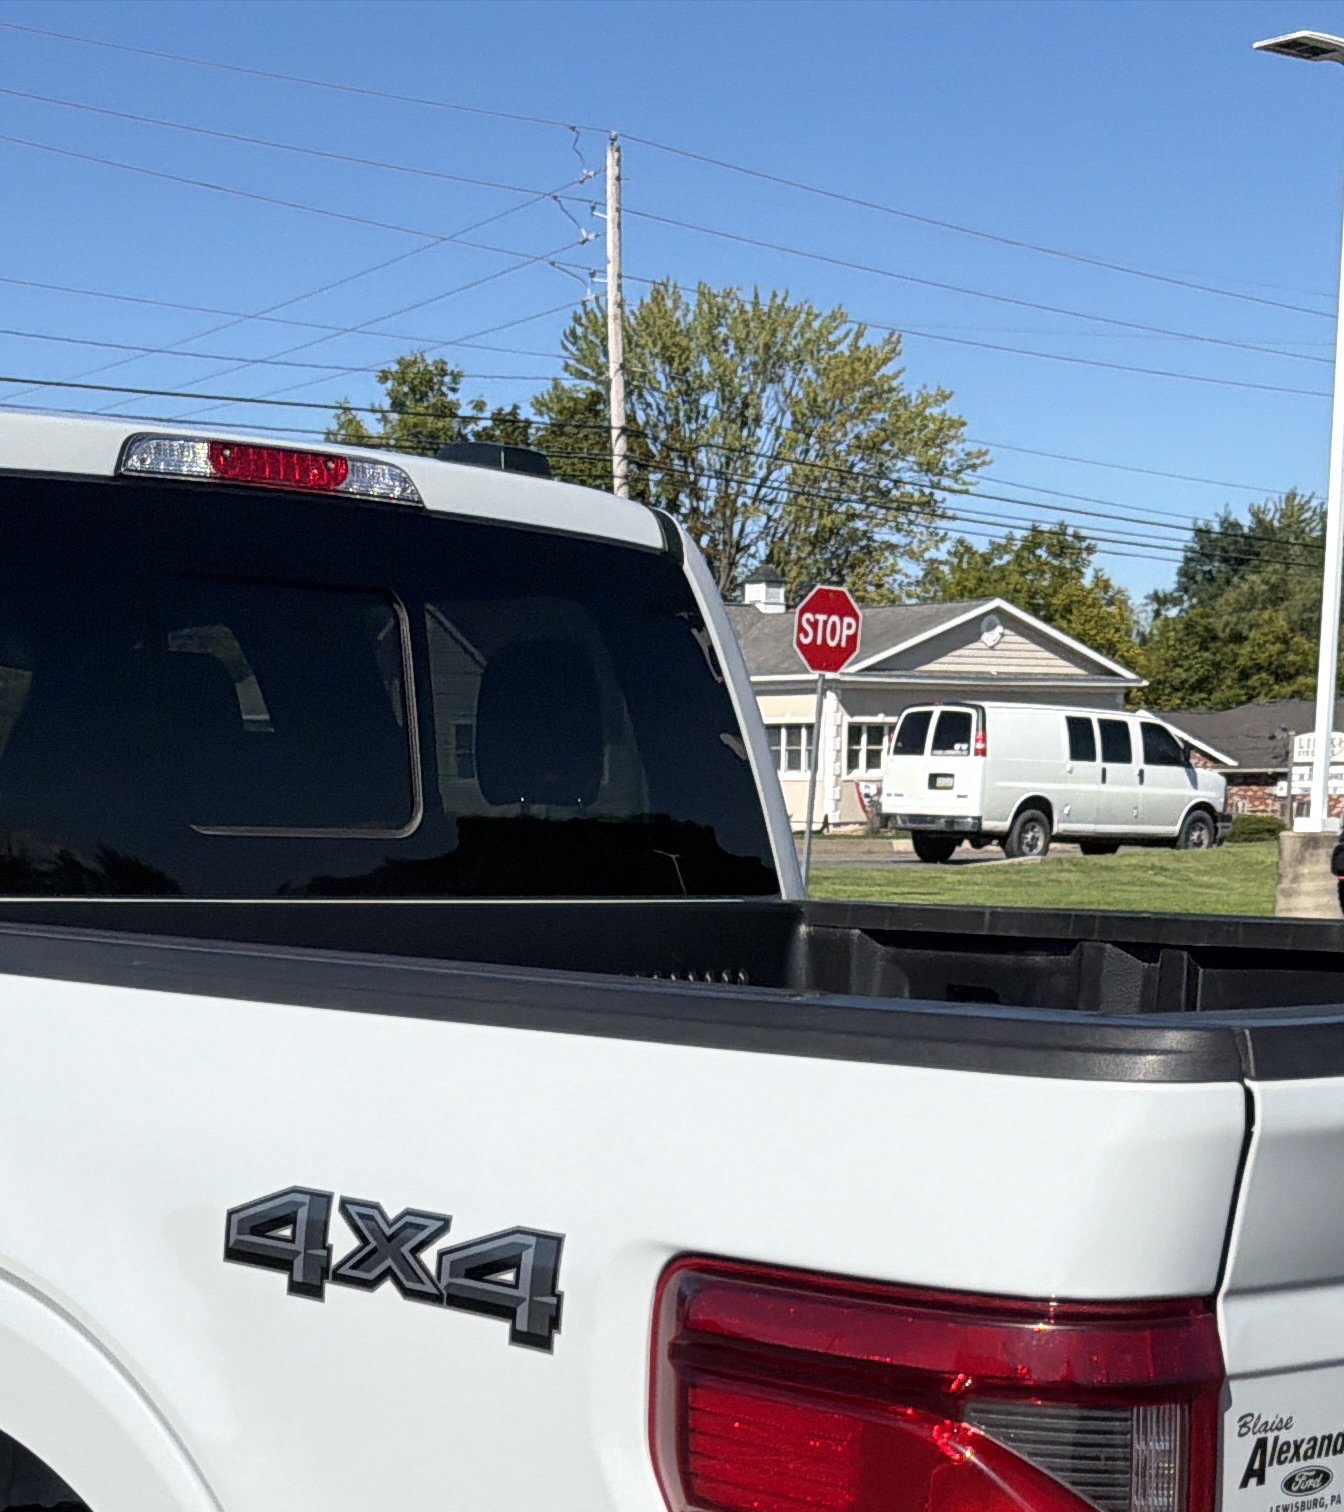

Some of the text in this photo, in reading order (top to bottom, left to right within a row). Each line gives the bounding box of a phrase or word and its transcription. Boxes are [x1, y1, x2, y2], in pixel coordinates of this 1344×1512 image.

[799, 612, 857, 649] STOP
[1236, 1412, 1295, 1438] Blaise
[1290, 1470, 1324, 1492] Ford
[1330, 1493, 1342, 1507] PA
